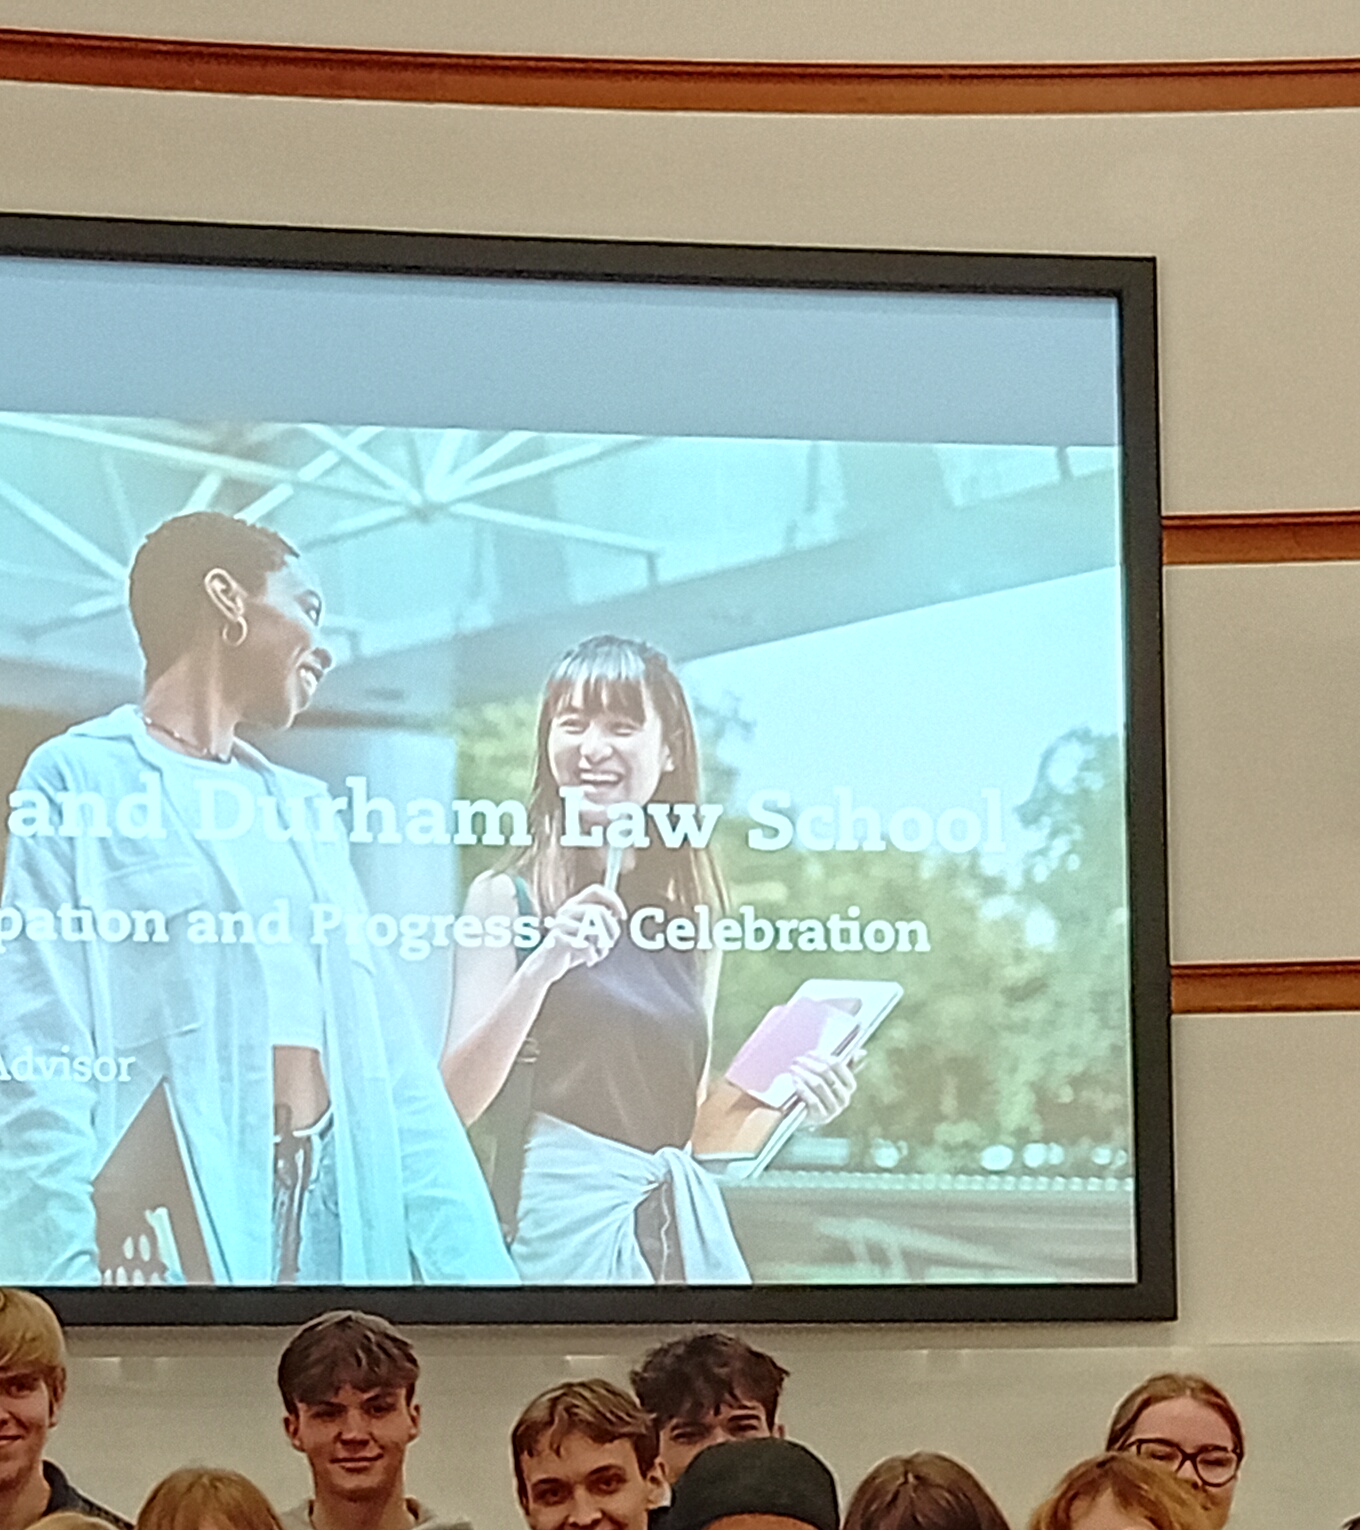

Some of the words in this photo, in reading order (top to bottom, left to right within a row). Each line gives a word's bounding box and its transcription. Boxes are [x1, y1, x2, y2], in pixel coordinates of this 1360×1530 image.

[7, 771, 168, 838] and
[194, 776, 533, 846] Durham
[559, 786, 724, 849] Law
[747, 787, 1006, 853] School
[187, 899, 293, 946] and
[576, 909, 619, 949] A
[630, 905, 931, 952] Celebration
